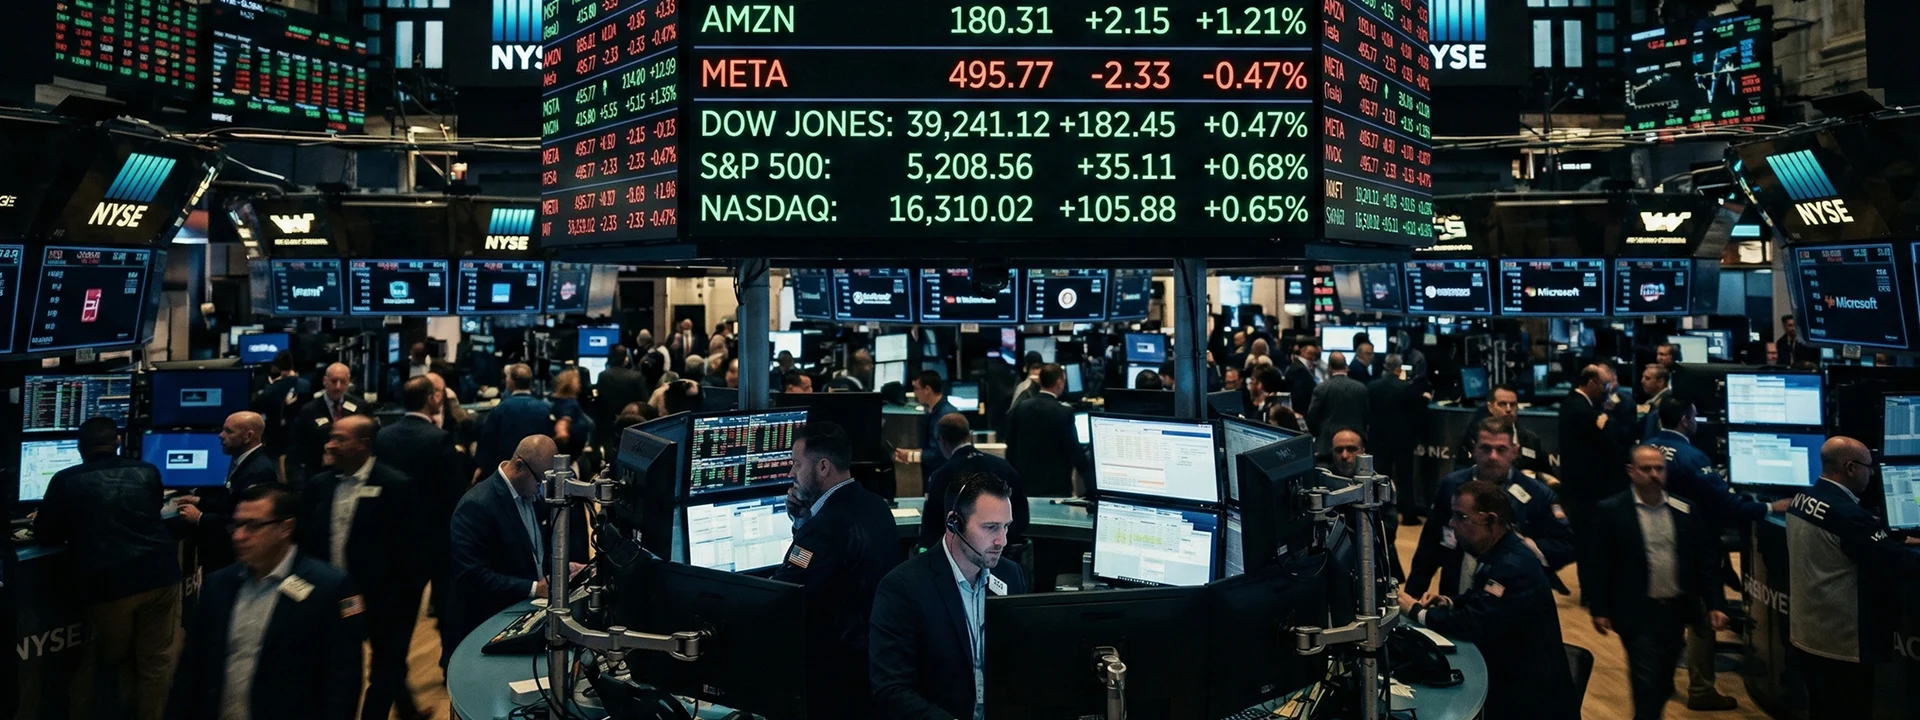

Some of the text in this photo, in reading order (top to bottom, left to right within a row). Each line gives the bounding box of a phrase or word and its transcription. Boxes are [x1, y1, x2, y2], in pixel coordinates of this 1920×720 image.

[701, 5, 1307, 34] AMZN 180.31 +2.15 +1.21%
[649, 57, 676, 79] +12.99
[702, 60, 1308, 90] META 495.77 -2.33 -0.47%
[701, 109, 1308, 142] DOW JONES: 39,241.12 +182.45 +0.47%
[700, 152, 1309, 184] S&P 500: 5,208.56 +35.11 +0.68%
[88, 202, 148, 228] NYSE
[701, 194, 837, 223] NASDAQ:
[889, 194, 1034, 227] 16,310.02
[1059, 194, 1177, 223] +105.88
[1204, 195, 1309, 223] +0.65%
[1795, 199, 1854, 226] NYSE
[484, 235, 530, 251] NYSE
[1790, 492, 1830, 520] NYSE
